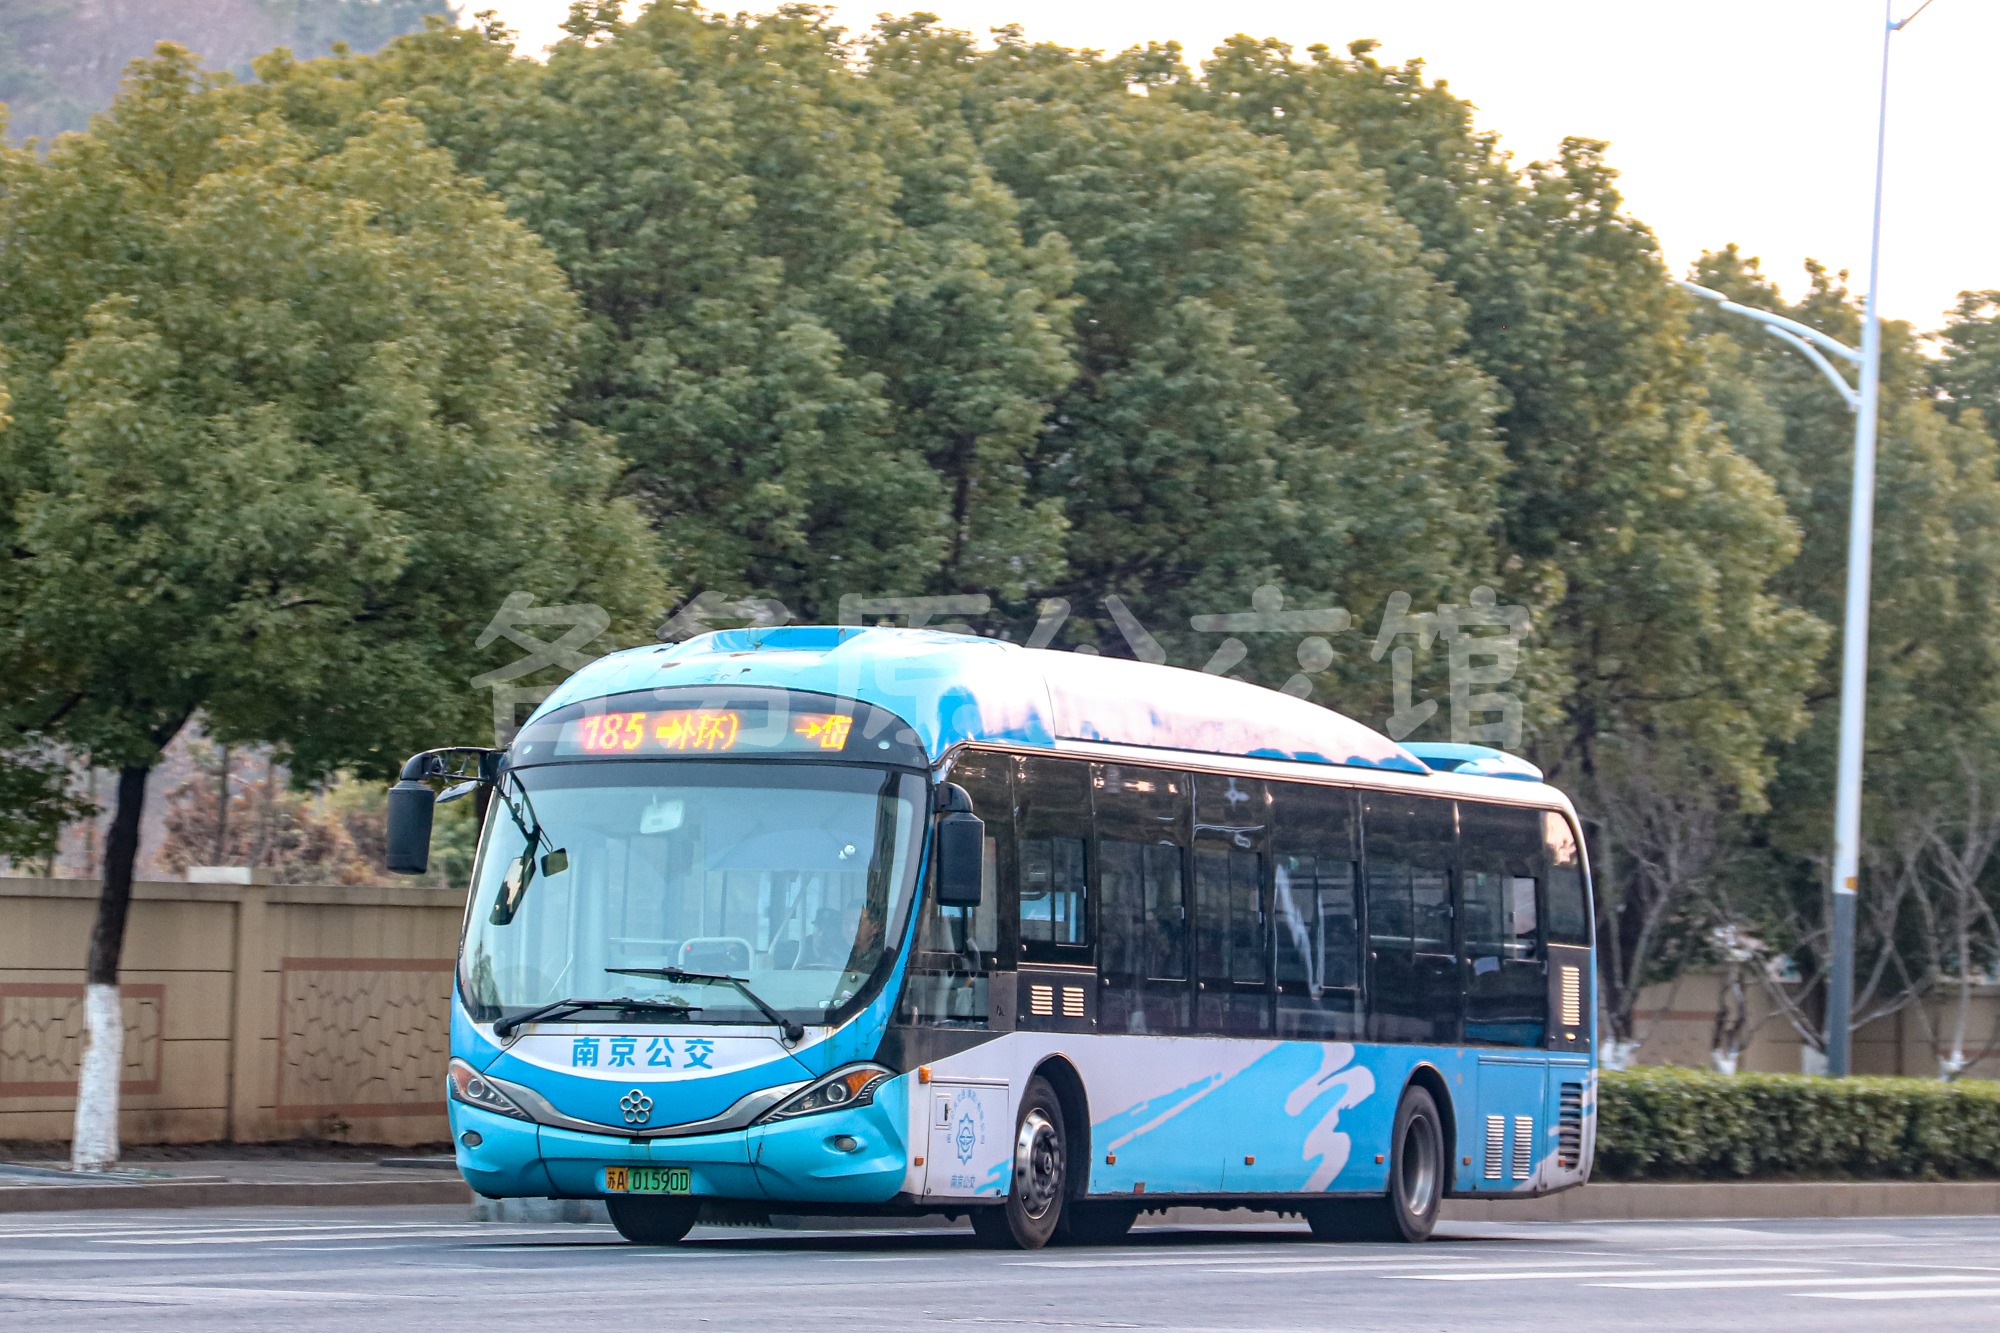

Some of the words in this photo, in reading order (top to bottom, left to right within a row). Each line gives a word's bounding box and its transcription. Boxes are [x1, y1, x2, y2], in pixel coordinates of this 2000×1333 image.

[583, 712, 646, 750] 185
[572, 1036, 714, 1070] 南京公交
